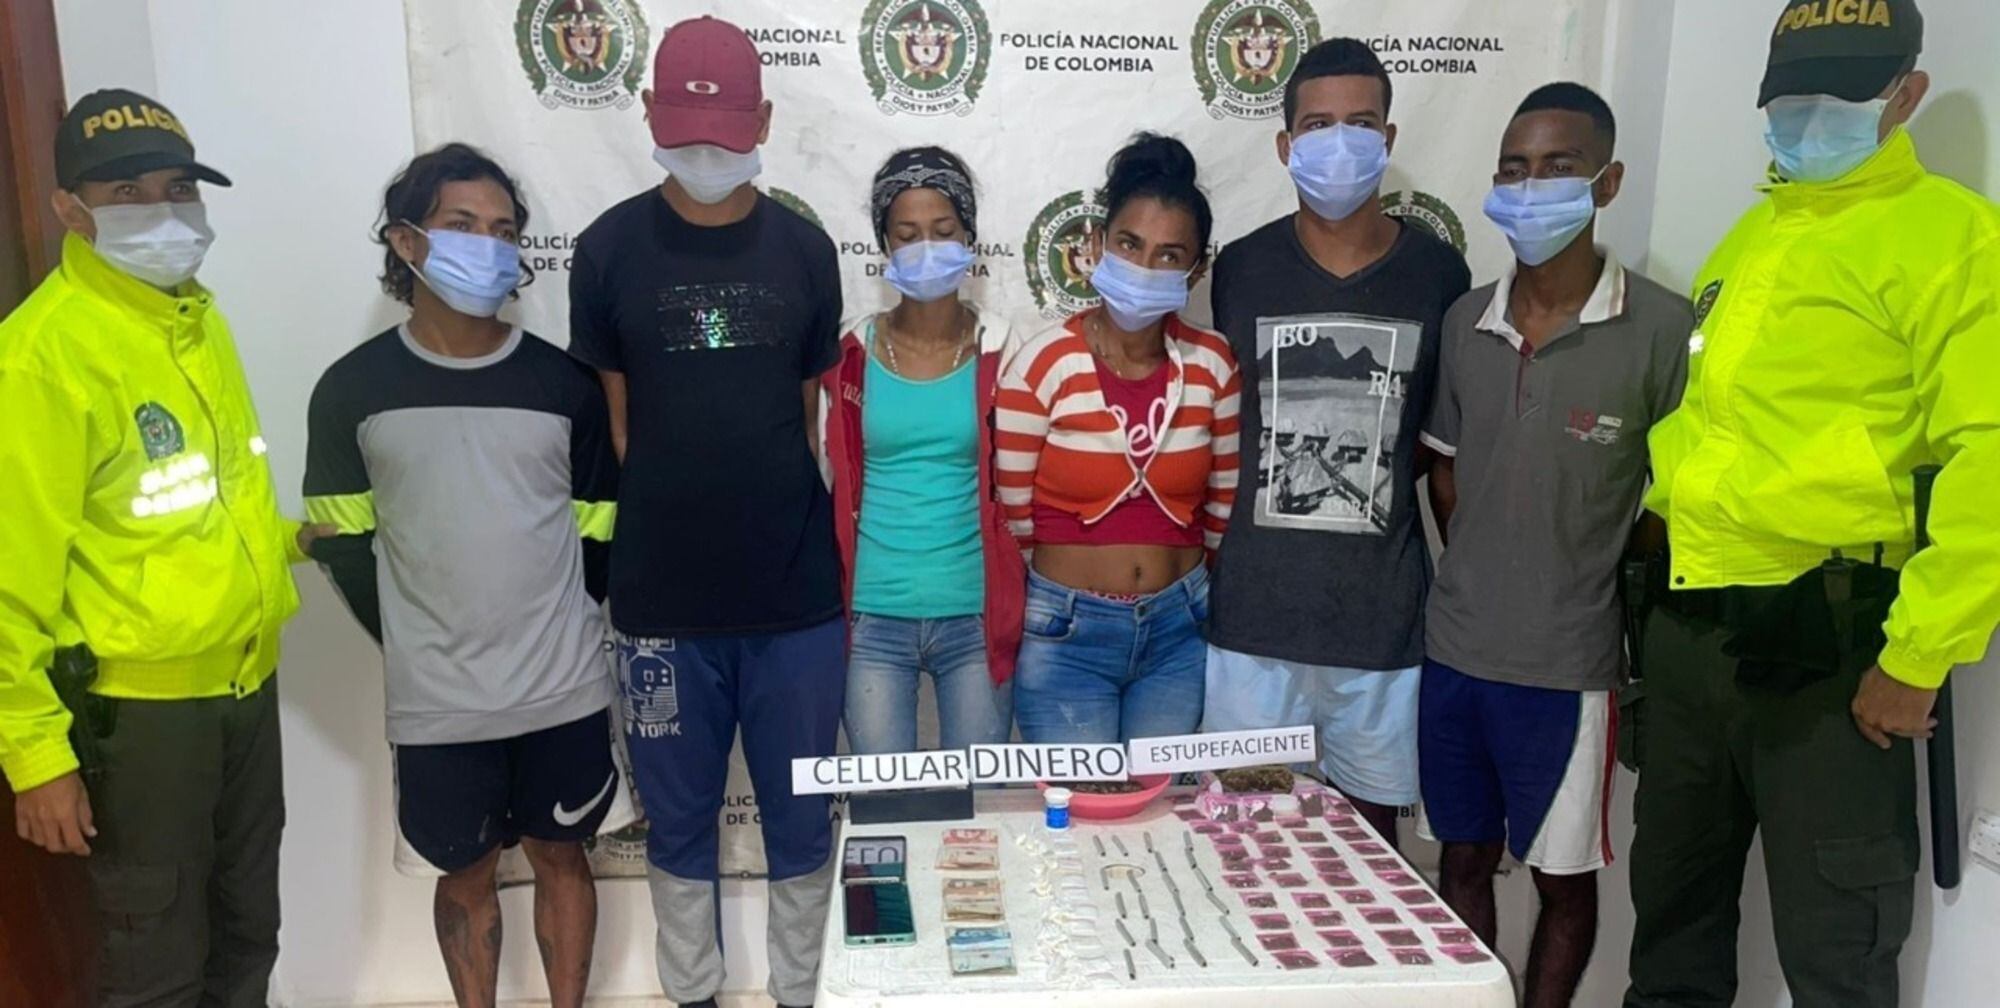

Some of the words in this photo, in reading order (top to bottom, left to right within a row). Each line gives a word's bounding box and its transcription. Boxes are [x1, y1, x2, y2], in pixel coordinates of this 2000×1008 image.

[745, 28, 846, 43] NACIONAL
[1276, 2, 1309, 53] COLOMBI
[1000, 30, 1075, 48] POLICÍA
[1080, 34, 1179, 50] NACIONAL
[1365, 34, 1403, 53] ICÍA
[1408, 36, 1504, 52] NACIONAL
[760, 51, 821, 66] OMBIA
[1024, 56, 1049, 71] DE
[1054, 57, 1154, 72] COLOMBIA
[1382, 58, 1478, 74] COLOMBIA
[1256, 82, 1288, 102] NACIO
[519, 232, 580, 250] OLICÍA
[534, 256, 558, 271] DE
[637, 722, 682, 738] YORK
[1150, 733, 1311, 763] ESTUPEFACIENTE
[813, 755, 963, 785] CELULAR
[974, 747, 1124, 779] DINERO
[726, 813, 748, 825] DE
